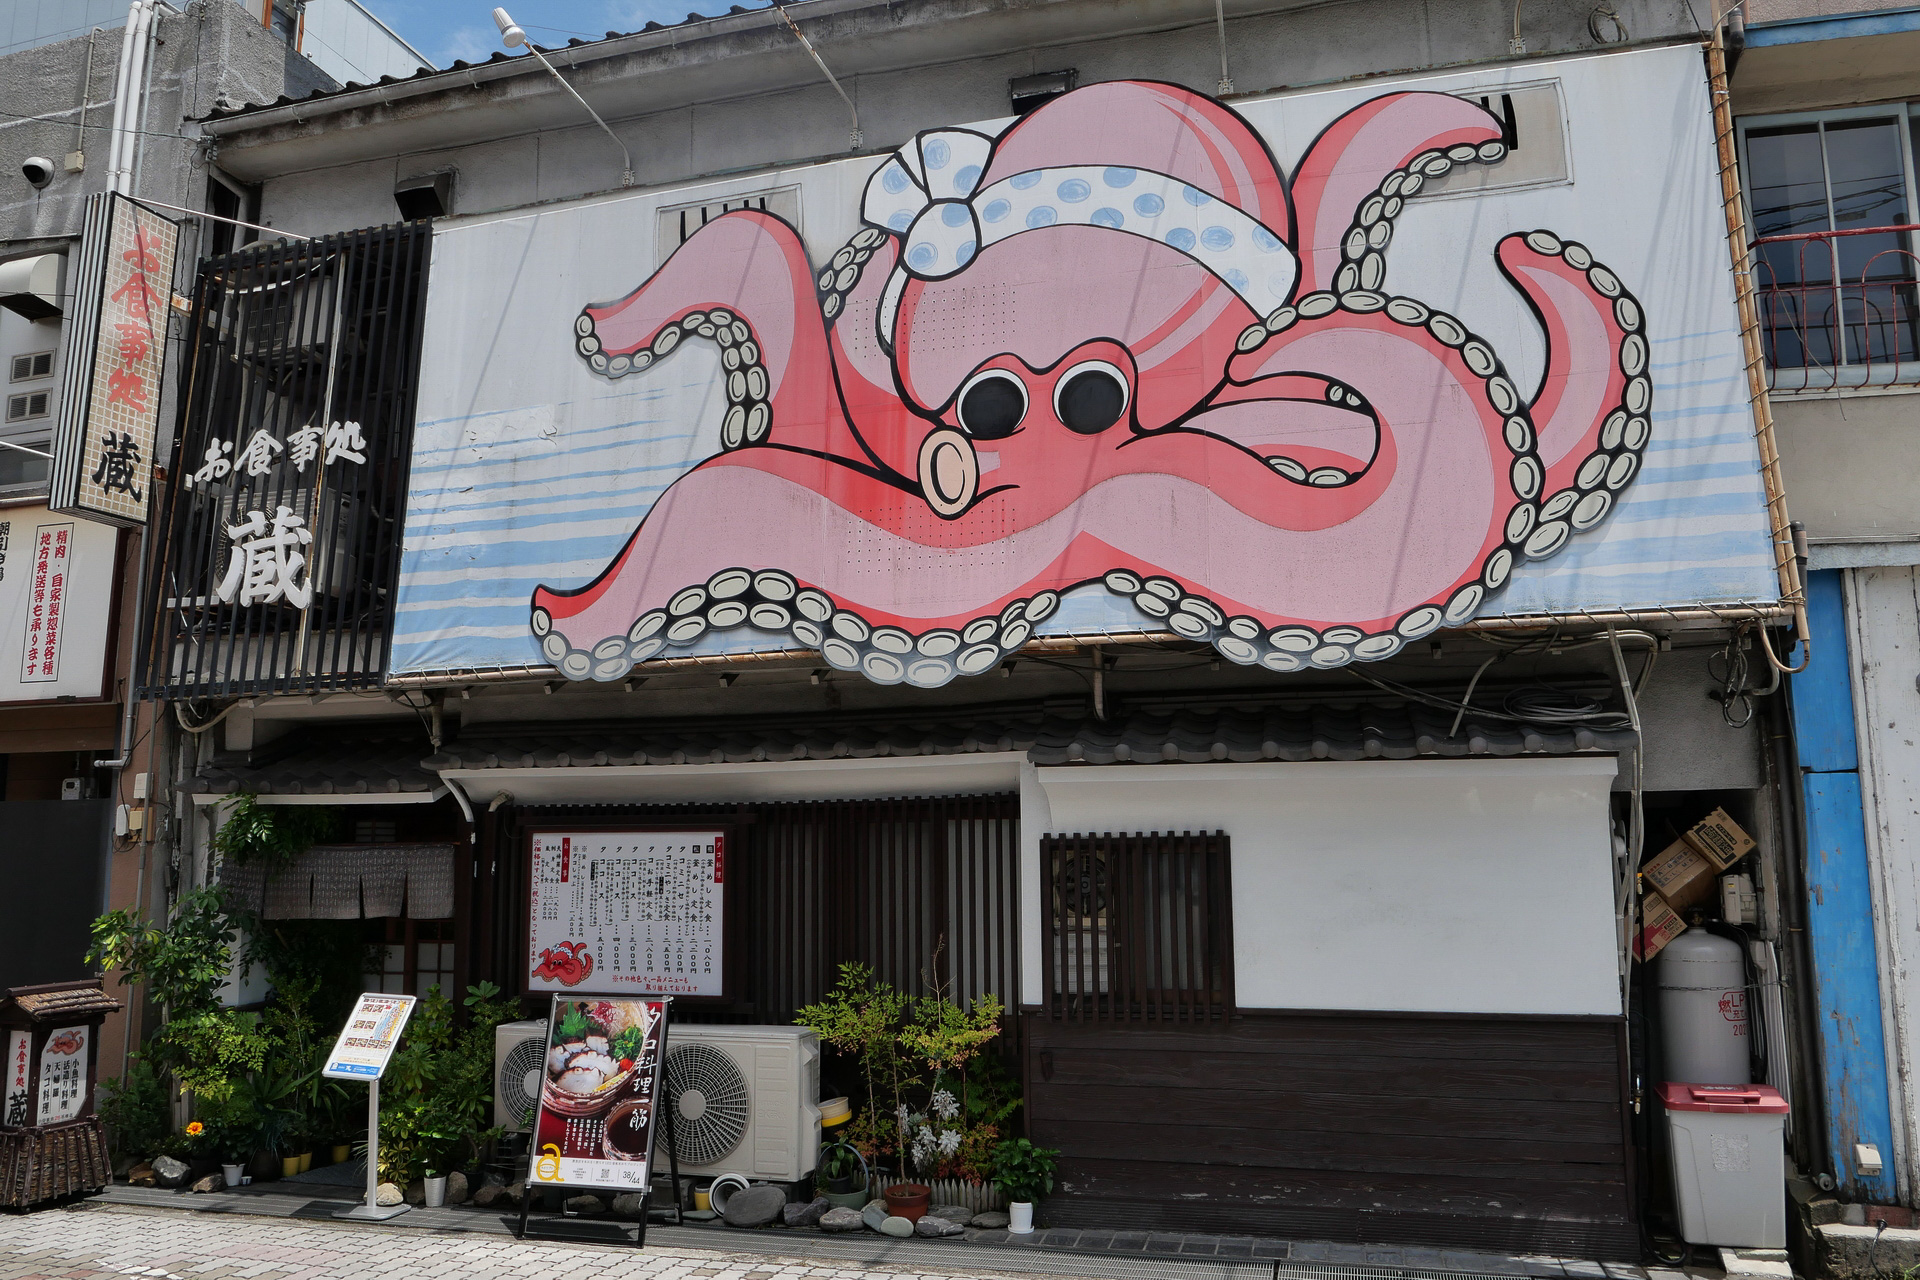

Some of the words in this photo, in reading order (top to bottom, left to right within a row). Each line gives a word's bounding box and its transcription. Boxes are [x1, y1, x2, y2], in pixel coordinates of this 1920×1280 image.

[108, 225, 162, 414] お食事処
[91, 430, 142, 503] 蔵
[193, 421, 367, 483] お食事処
[216, 505, 313, 610] 蔵
[26, 532, 52, 676] 地方発送等も承ります
[15, 1038, 28, 1088] お食事処
[41, 1063, 51, 1114] タコ料理
[7, 1089, 29, 1126] 蔵
